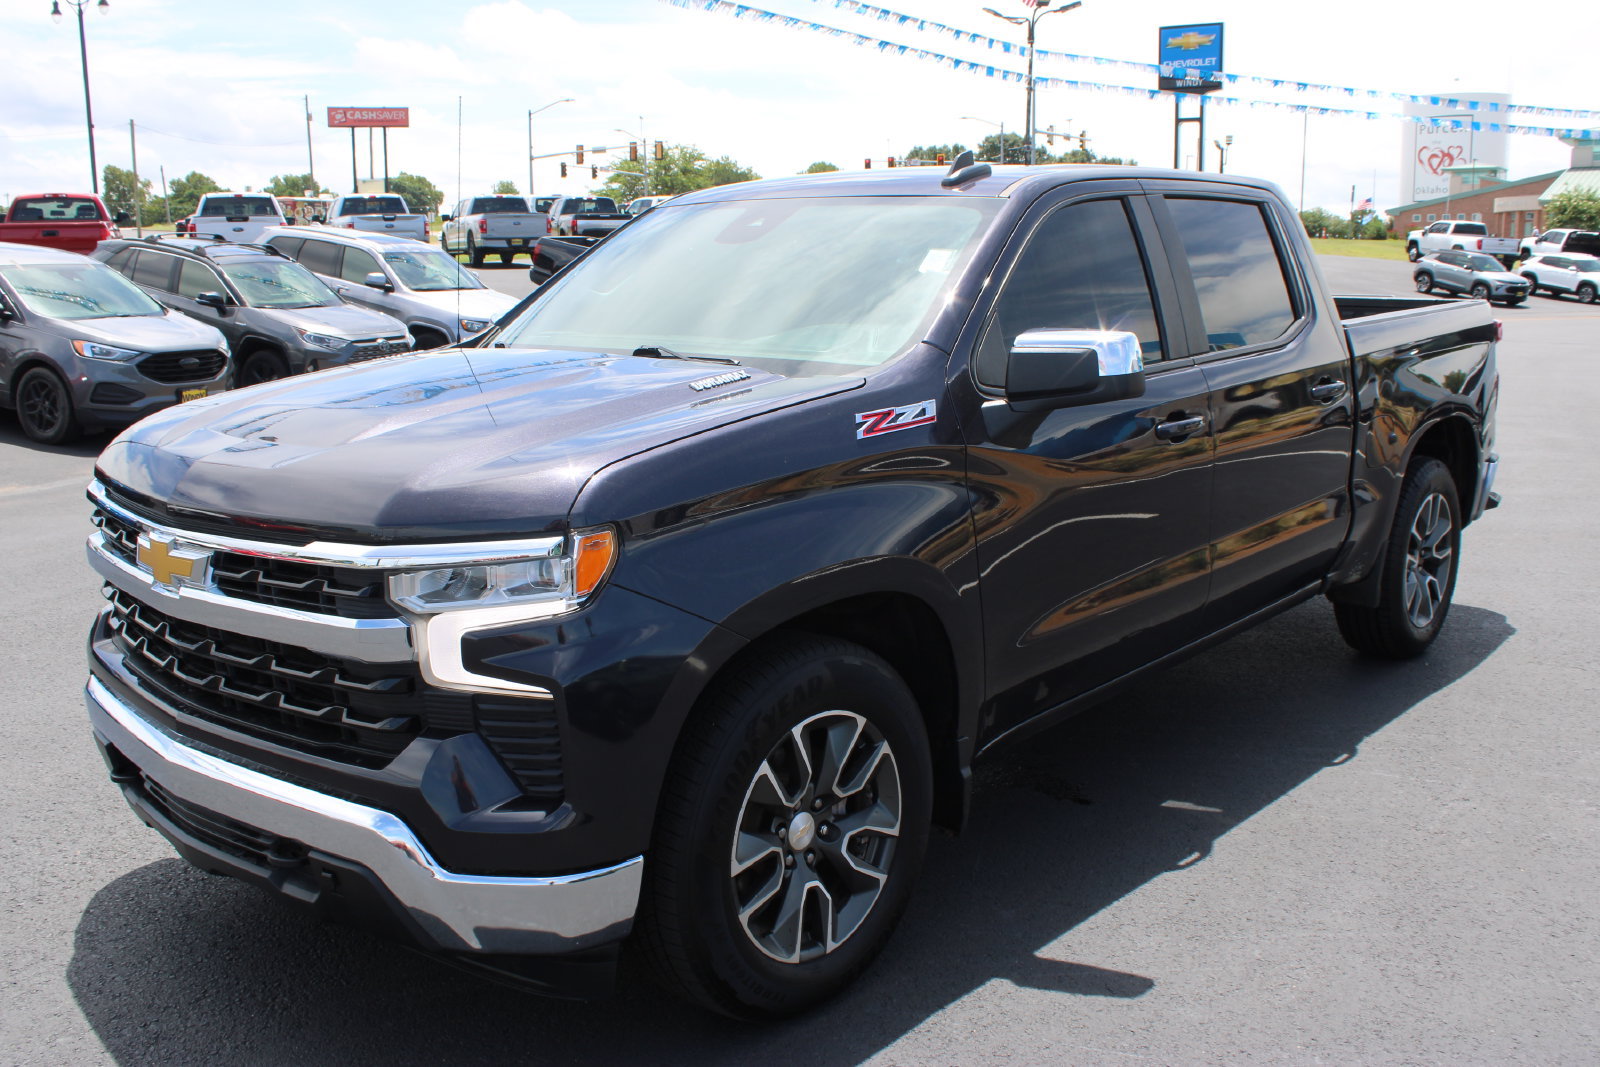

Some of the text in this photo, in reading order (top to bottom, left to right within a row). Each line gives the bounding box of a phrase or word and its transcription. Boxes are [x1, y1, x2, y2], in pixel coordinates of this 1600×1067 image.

[1163, 57, 1217, 68] CHEVROLET
[1175, 79, 1203, 87] WINDY
[1415, 185, 1449, 195] Oklaho
[688, 369, 752, 392] DURAMAX
[855, 398, 937, 440] Z71
